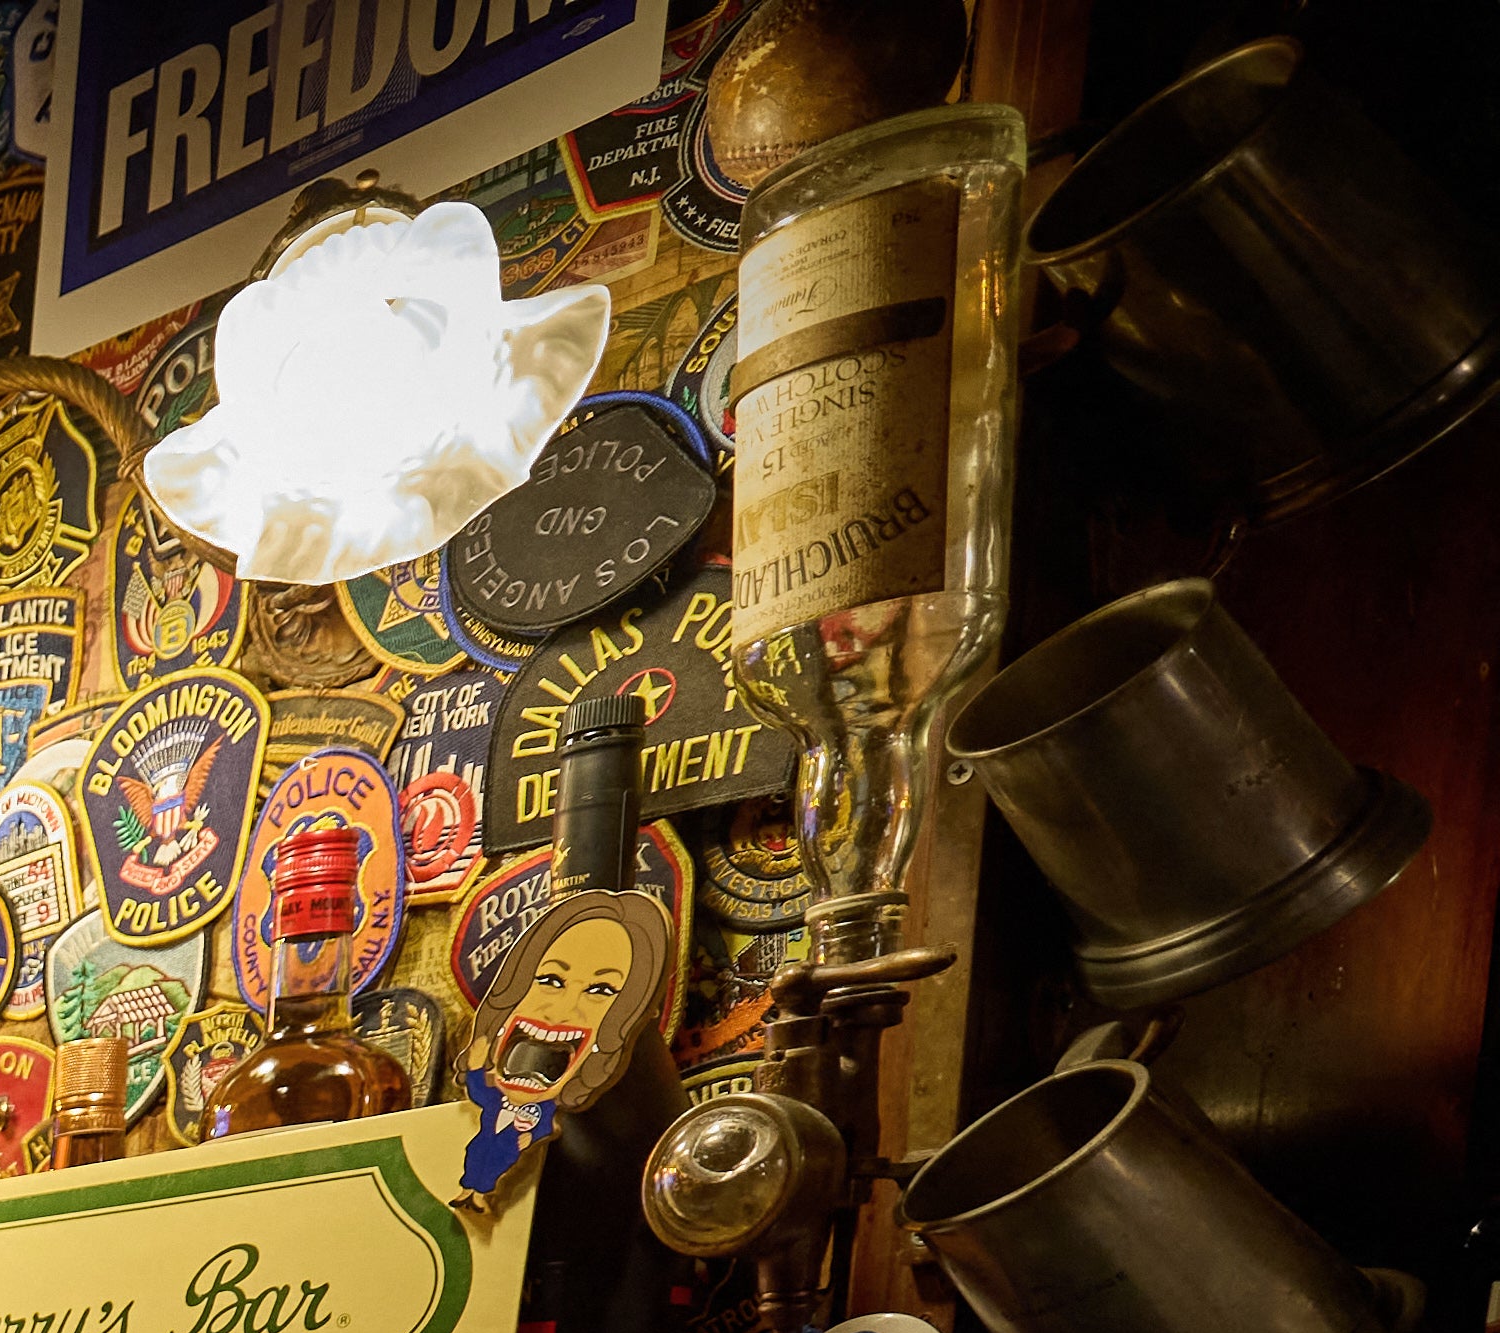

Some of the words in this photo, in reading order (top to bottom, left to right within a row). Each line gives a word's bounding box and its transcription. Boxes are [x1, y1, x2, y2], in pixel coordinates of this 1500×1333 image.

[636, 114, 679, 140] FIRE
[705, 217, 742, 242] FIEL
[535, 439, 667, 486] POLICE
[465, 513, 581, 612] ANGELES
[595, 514, 681, 588] LOS
[192, 628, 230, 655] 1843
[412, 687, 450, 715] CITY
[456, 680, 485, 706] OF
[441, 701, 492, 730] YORK
[512, 606, 645, 760] DALLAS
[87, 683, 258, 798] BLOOMINGTON
[517, 722, 763, 824] DETMENT
[267, 764, 376, 830] POLICE
[113, 869, 223, 935] POLICE
[243, 913, 269, 993] COUNTY
